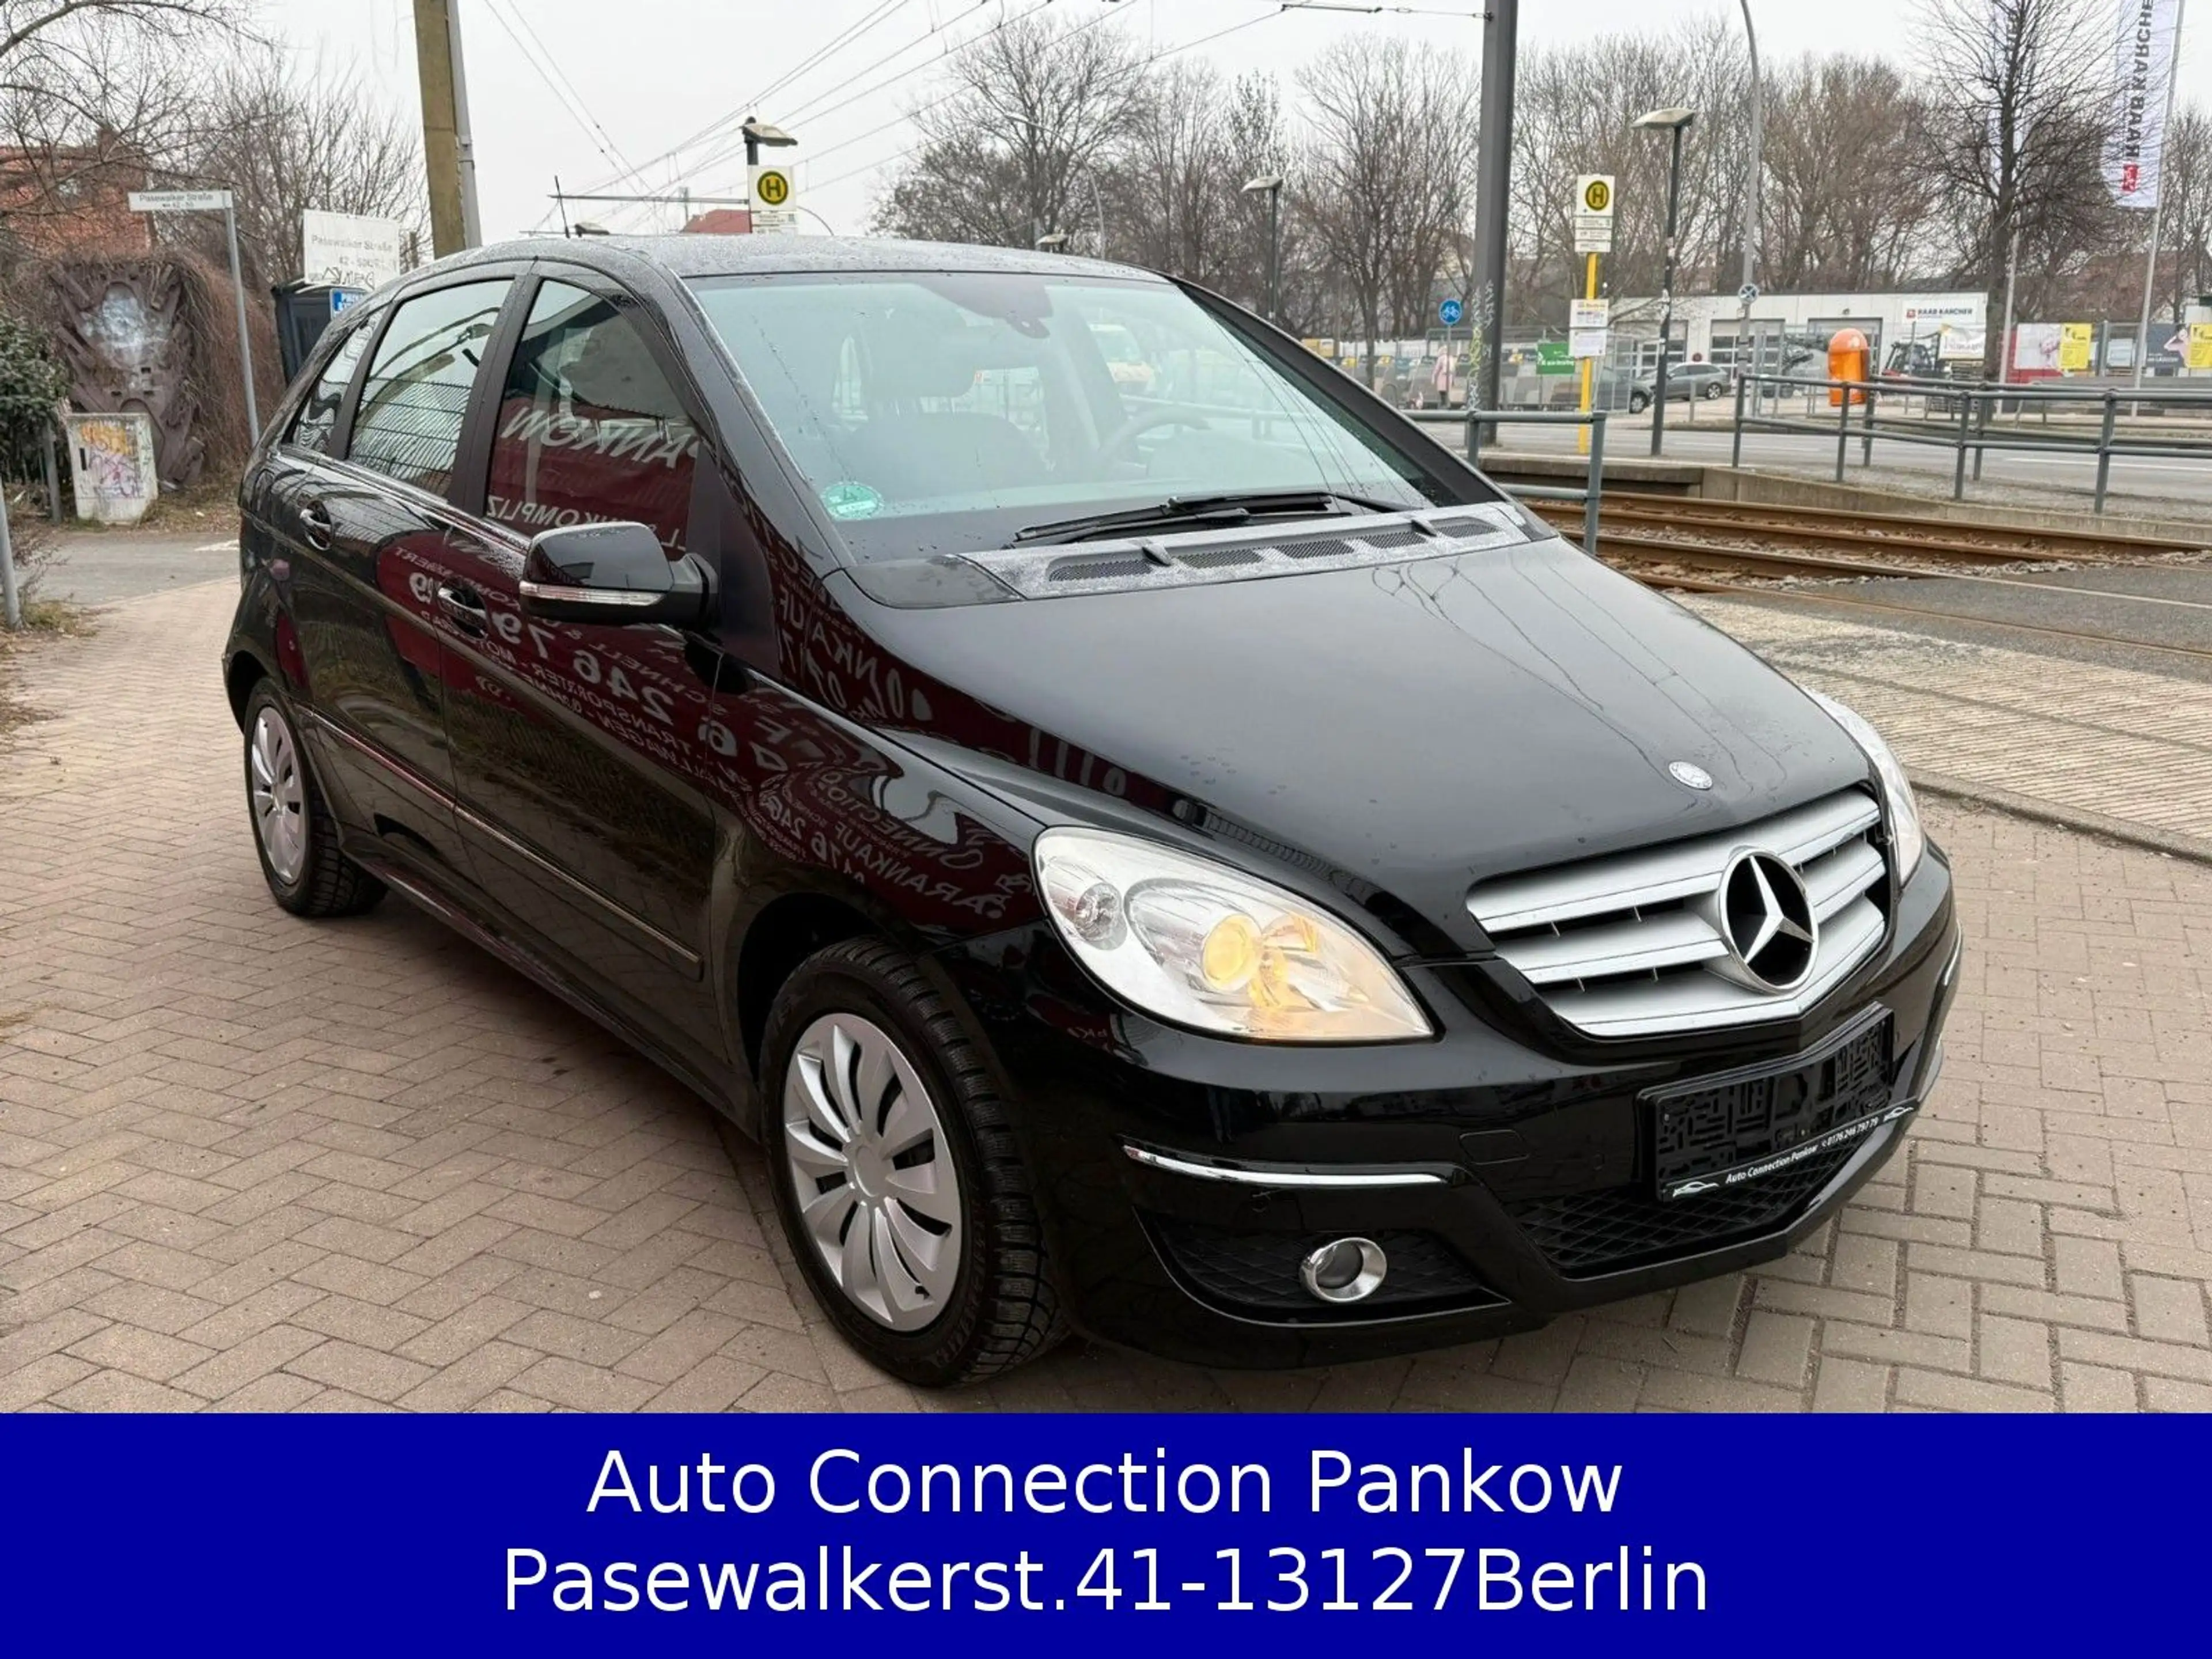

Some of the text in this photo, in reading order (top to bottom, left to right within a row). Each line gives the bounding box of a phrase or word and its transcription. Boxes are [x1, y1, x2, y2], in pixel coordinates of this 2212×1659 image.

[766, 179, 781, 197] H
[1592, 187, 1604, 203] H
[1725, 1172, 1747, 1184] Auto
[1748, 1156, 1792, 1178] Connection
[1791, 1144, 1819, 1162] Pankow
